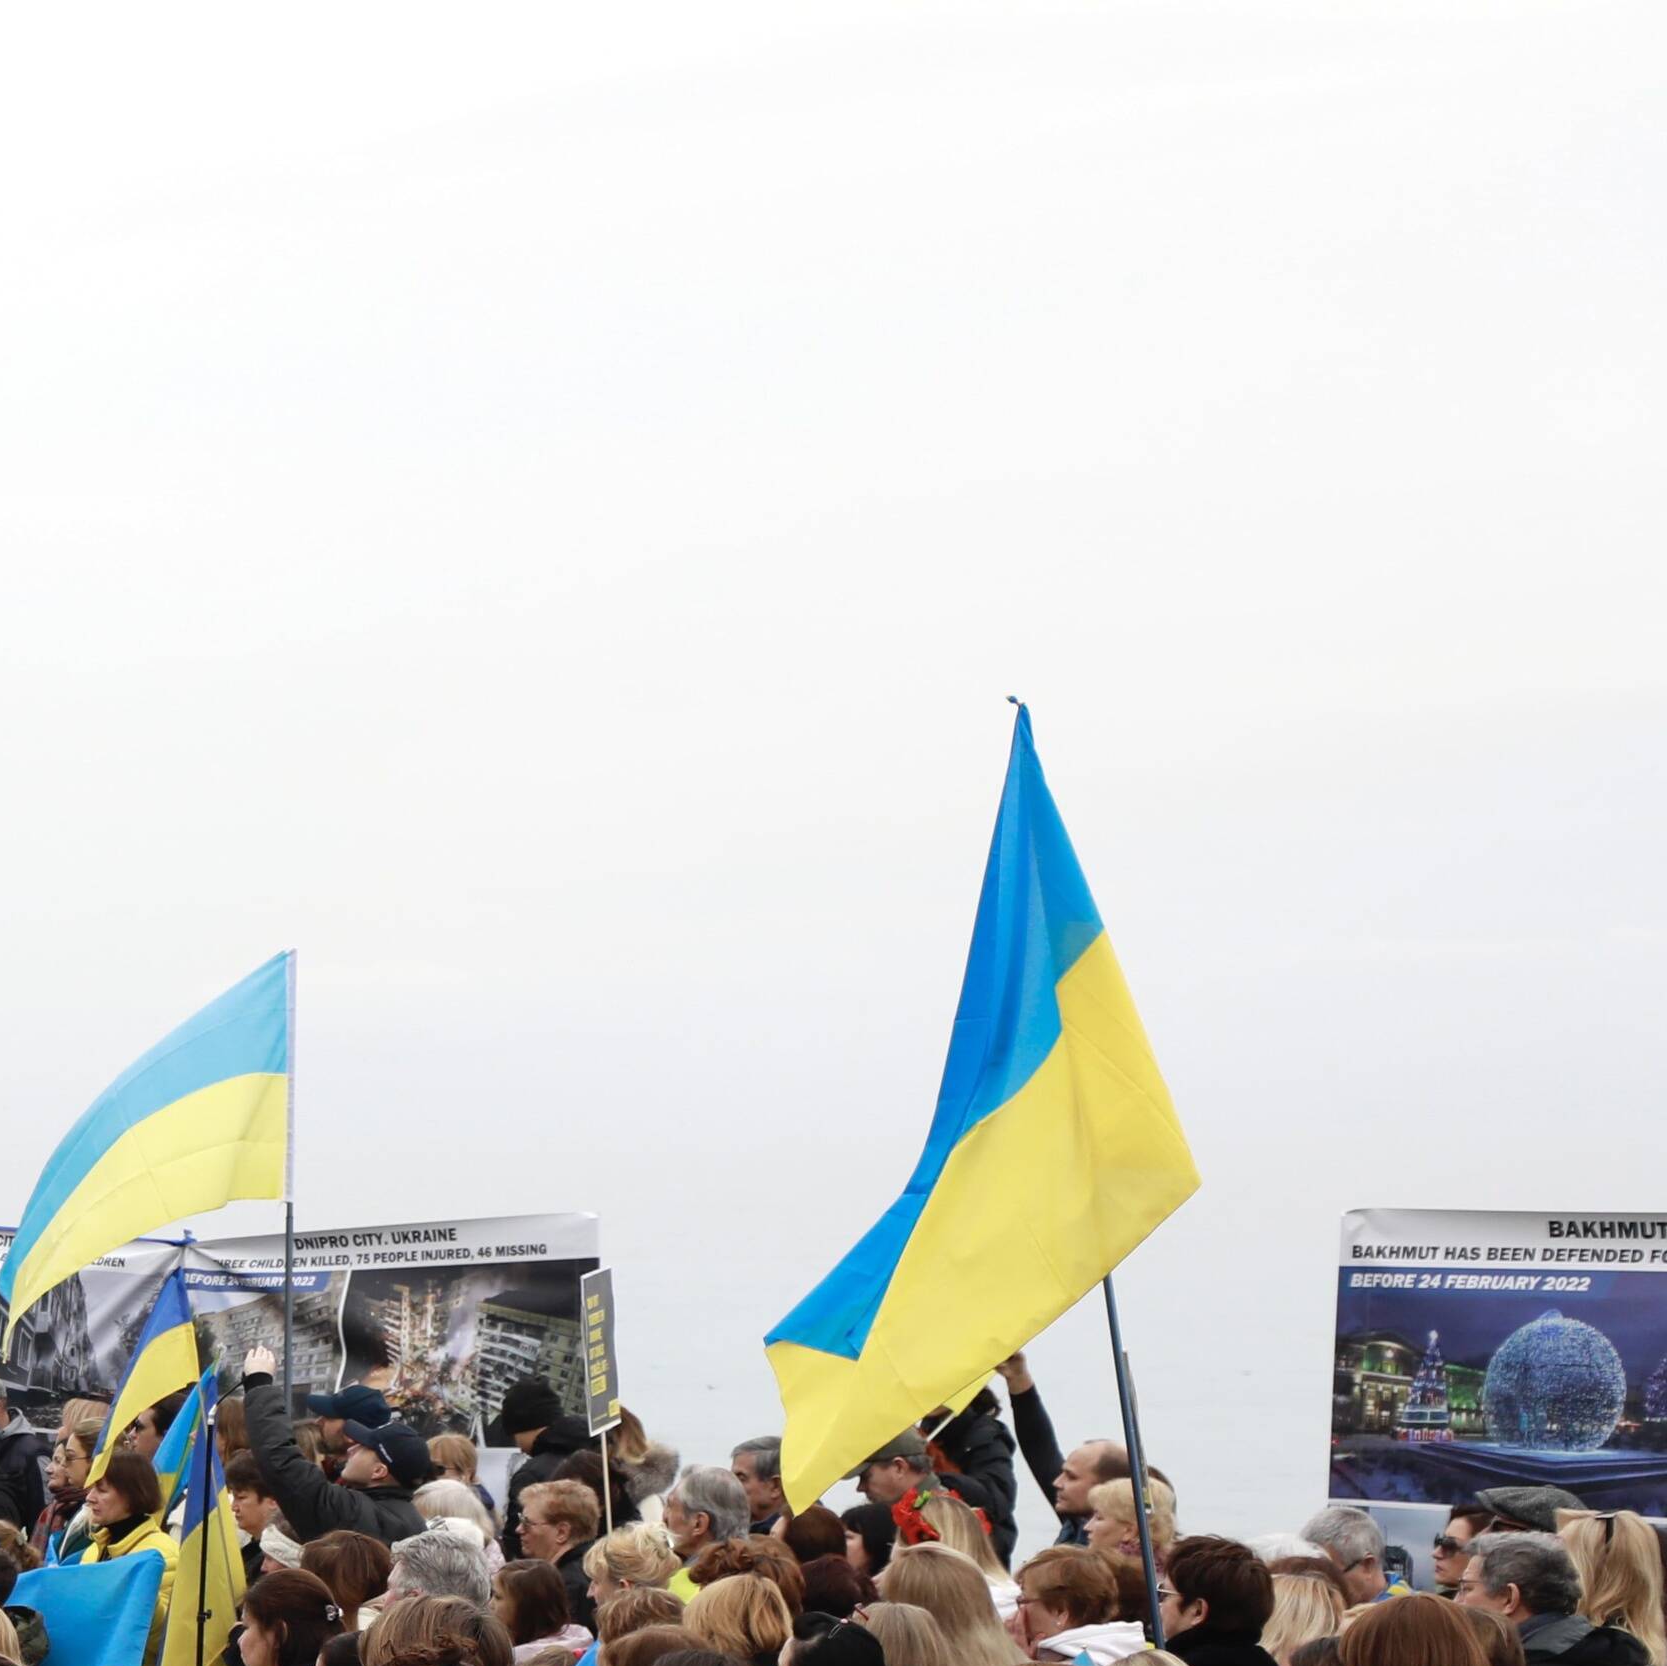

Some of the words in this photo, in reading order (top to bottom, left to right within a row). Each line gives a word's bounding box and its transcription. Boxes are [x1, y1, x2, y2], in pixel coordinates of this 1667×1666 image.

[293, 1233, 349, 1250] DNIPRO
[392, 1228, 457, 1245] UKRAINE
[1548, 1221, 1667, 1239] BAKHMUT
[249, 1256, 308, 1269] CHILDEN
[357, 1253, 371, 1265] 75
[373, 1251, 417, 1264] PEOPLE
[421, 1248, 474, 1261] INJURED,
[477, 1246, 492, 1258] 46
[495, 1244, 547, 1256] MISSING
[1352, 1245, 1439, 1261] BAKHMUT
[1444, 1247, 1481, 1262] HAS
[1486, 1247, 1536, 1262] BEEN
[1541, 1248, 1644, 1263] DEFENDED
[1350, 1273, 1416, 1288] BEFORE
[1418, 1274, 1441, 1289] 24
[1444, 1275, 1542, 1291] FEBRUARY
[1541, 1276, 1592, 1292] 2022
